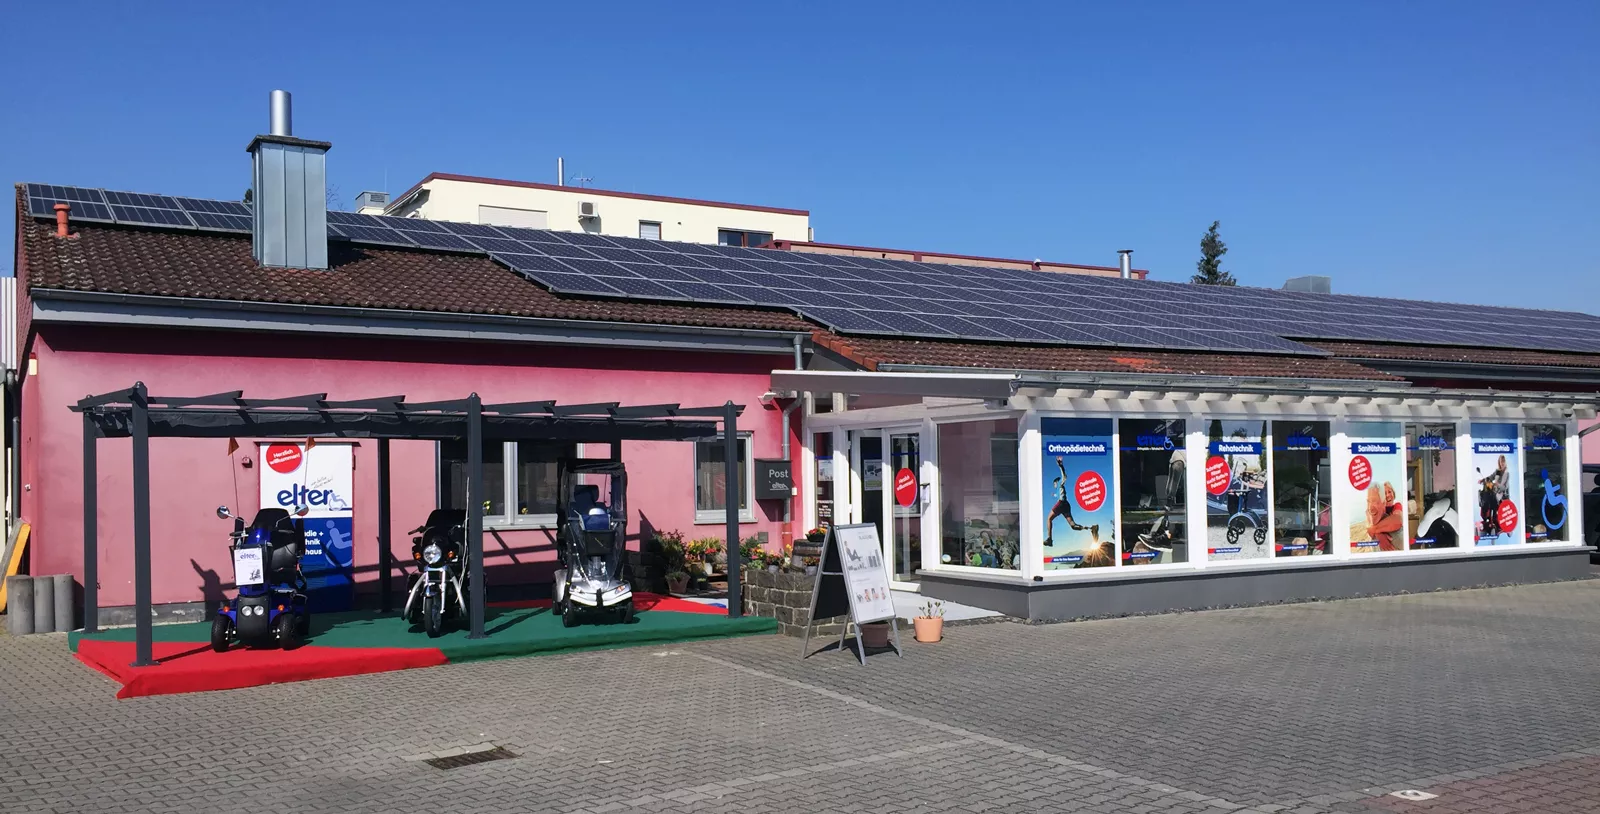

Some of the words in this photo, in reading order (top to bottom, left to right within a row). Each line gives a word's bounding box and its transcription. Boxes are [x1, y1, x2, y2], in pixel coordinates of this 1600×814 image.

[1048, 444, 1106, 454] Orthopädietechnik
[1218, 444, 1254, 453] Rehatechnik
[1357, 444, 1391, 453] Sanitätshaus
[1478, 444, 1511, 452] Meisterbetrieb
[273, 449, 294, 459] Herzlich
[269, 453, 301, 466] willkommen!
[769, 469, 789, 478] Post
[277, 483, 331, 507] elter
